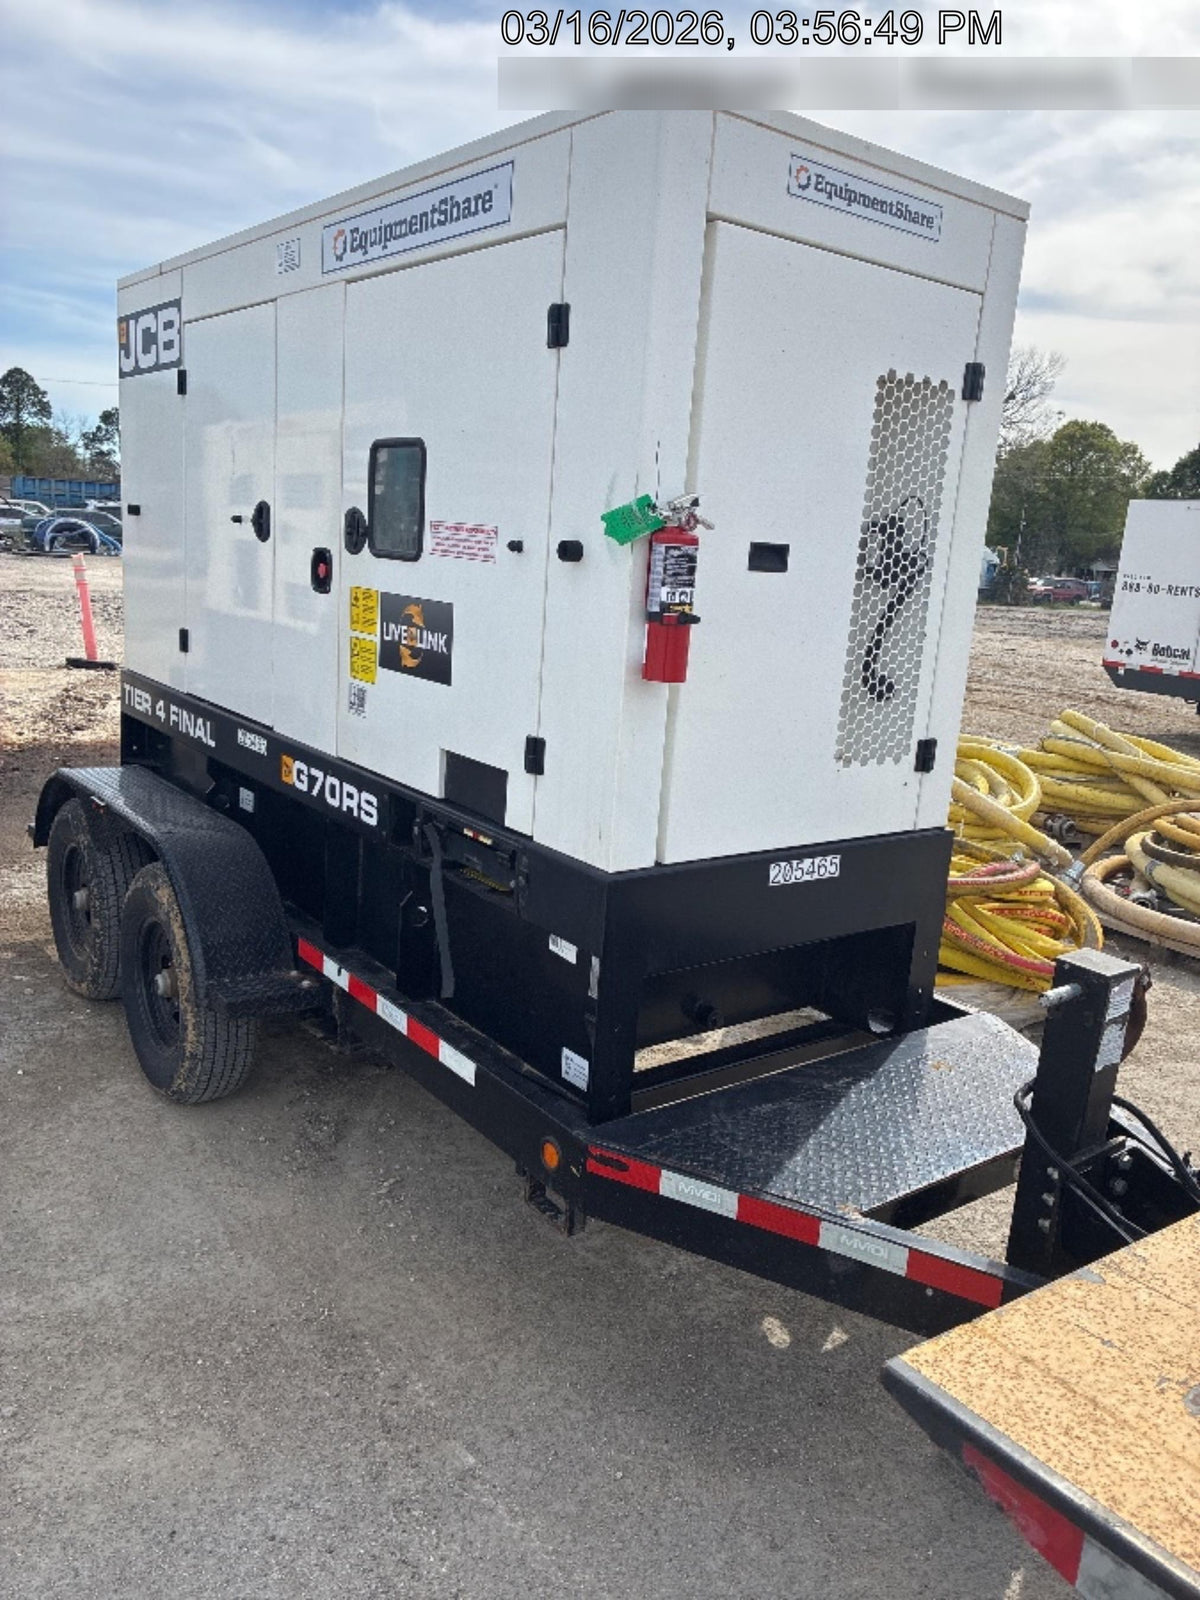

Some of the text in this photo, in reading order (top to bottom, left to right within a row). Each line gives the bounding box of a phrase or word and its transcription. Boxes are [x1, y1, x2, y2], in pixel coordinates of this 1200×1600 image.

[349, 187, 494, 253] EquipmentShare
[814, 172, 936, 231] EquipmentShare
[120, 306, 180, 372] JCB
[123, 683, 152, 717] TIER
[155, 704, 166, 722] 4
[169, 704, 216, 748] FINAL
[293, 759, 379, 827] G70RS
[769, 855, 840, 886] 205465
